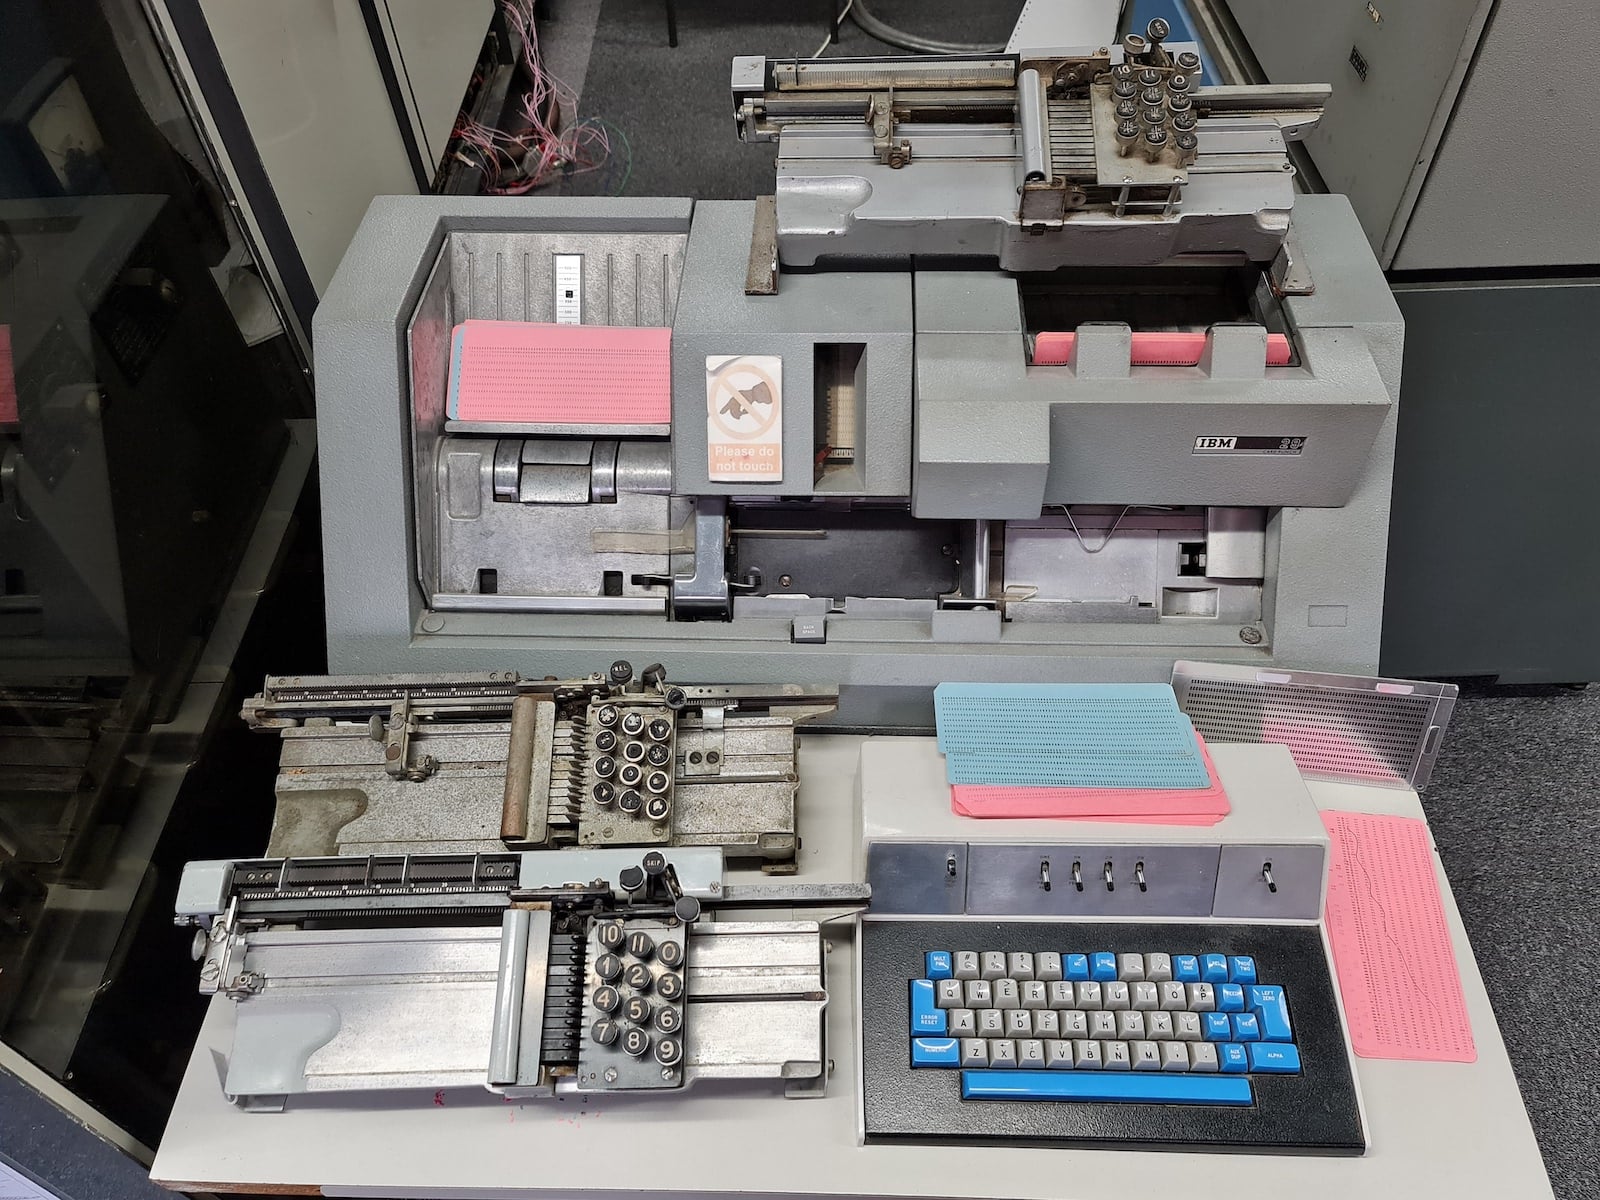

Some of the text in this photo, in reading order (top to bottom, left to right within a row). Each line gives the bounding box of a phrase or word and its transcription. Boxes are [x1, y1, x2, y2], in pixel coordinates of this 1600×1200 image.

[1199, 438, 1233, 448] IBM
[715, 445, 774, 457] Please do
[716, 461, 774, 472] not touch
[602, 925, 619, 943] 10
[632, 935, 644, 952] 11
[662, 943, 676, 961] 0
[602, 957, 610, 975] 1
[631, 966, 643, 984] 2
[662, 976, 675, 995] 3
[946, 989, 954, 997] Q
[976, 991, 983, 999] W
[1004, 988, 1011, 996] E
[1031, 990, 1038, 998] R
[1060, 991, 1066, 999] T
[1087, 991, 1093, 999] Y
[1114, 991, 1121, 999] U
[1171, 990, 1178, 999] O
[1200, 992, 1206, 1000] P
[596, 990, 609, 1008] 4
[630, 1001, 642, 1019] 5
[660, 1010, 672, 1028] 6
[960, 1019, 967, 1027] A
[989, 1020, 995, 1028] S
[1017, 1020, 1023, 1028] D
[1044, 1021, 1051, 1029] F
[1072, 1021, 1080, 1029] G
[1102, 1021, 1109, 1029] H
[1158, 1022, 1165, 1030] K
[1186, 1022, 1193, 1031] L
[597, 1023, 609, 1042] 7
[628, 1032, 640, 1050] 8
[660, 1040, 675, 1059] 9
[972, 1048, 979, 1057] Z
[1001, 1050, 1008, 1058] X
[1029, 1050, 1036, 1058] C
[1059, 1050, 1065, 1058] V
[1087, 1050, 1094, 1059] B
[1115, 1052, 1122, 1060] N
[1145, 1051, 1153, 1060] M
